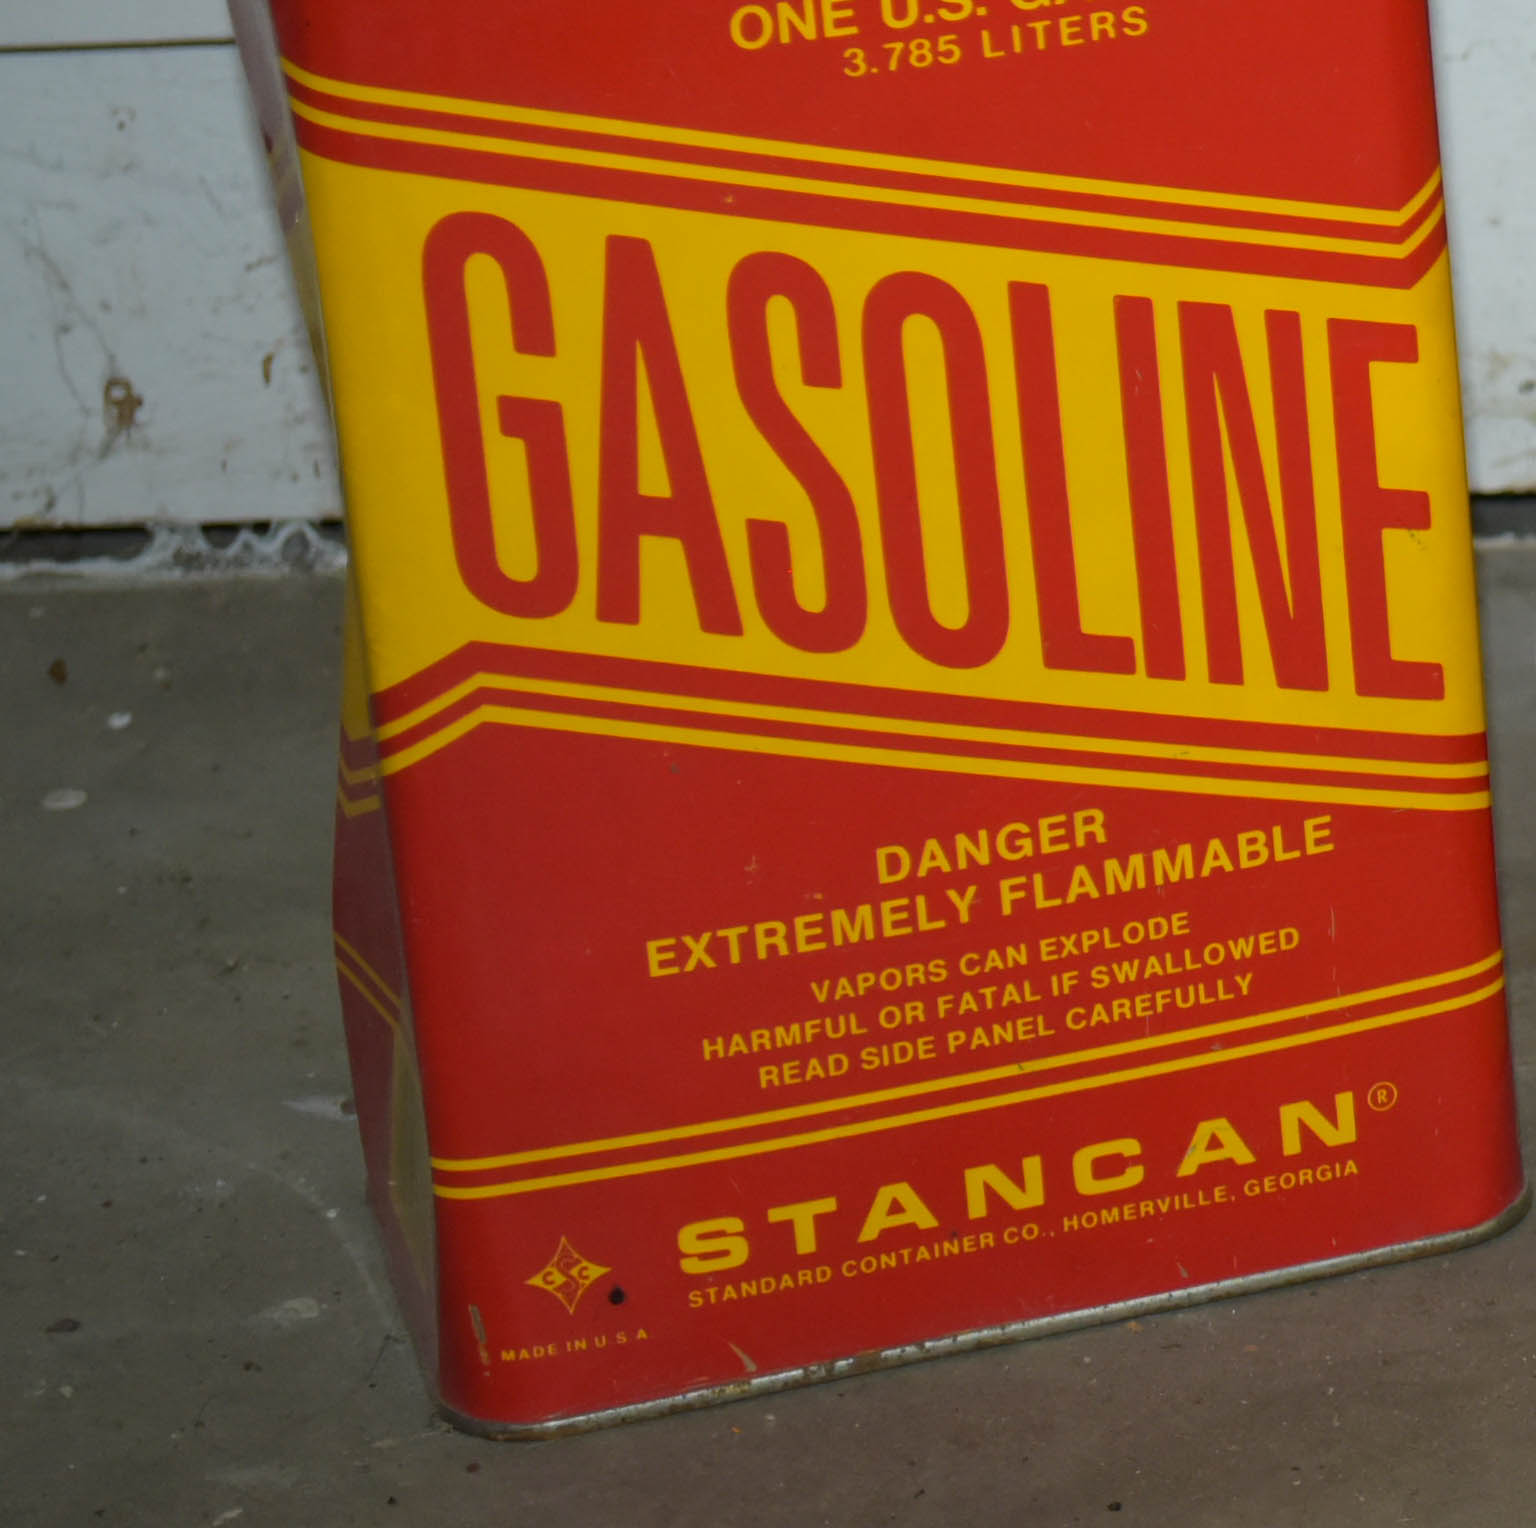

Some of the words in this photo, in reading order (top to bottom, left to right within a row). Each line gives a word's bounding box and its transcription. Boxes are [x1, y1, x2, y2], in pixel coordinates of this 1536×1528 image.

[843, 31, 962, 77] 3.785
[983, 7, 1151, 59] LITERS
[422, 211, 1446, 701] GASOLINE
[646, 886, 978, 978] EXTREMELY
[999, 815, 1335, 917] FLAMMABLE
[876, 808, 1108, 884] DANGER
[702, 1015, 868, 1061] HARMFUL
[879, 1000, 926, 1030] OR
[938, 981, 1042, 1019] FATAL
[1051, 970, 1080, 998] IF
[1090, 927, 1300, 990] SWALLOWED
[811, 960, 948, 1004] VAPORS
[959, 944, 1029, 978] CAN
[1039, 912, 1191, 963] EXPLODE
[759, 1053, 850, 1089] READ
[860, 1038, 937, 1071] SIDE
[948, 1015, 1054, 1055] PANEL
[1065, 973, 1254, 1031] CAREFULLY
[677, 1090, 1357, 1275] STANCAN
[688, 1266, 832, 1308] STANDARD
[841, 1232, 995, 1278] CONTAINER
[1063, 1185, 1237, 1233] HOMERVILLE,
[1244, 1160, 1358, 1195] GEORGIA
[501, 1343, 557, 1362] MADE
[567, 1337, 587, 1352] IN
